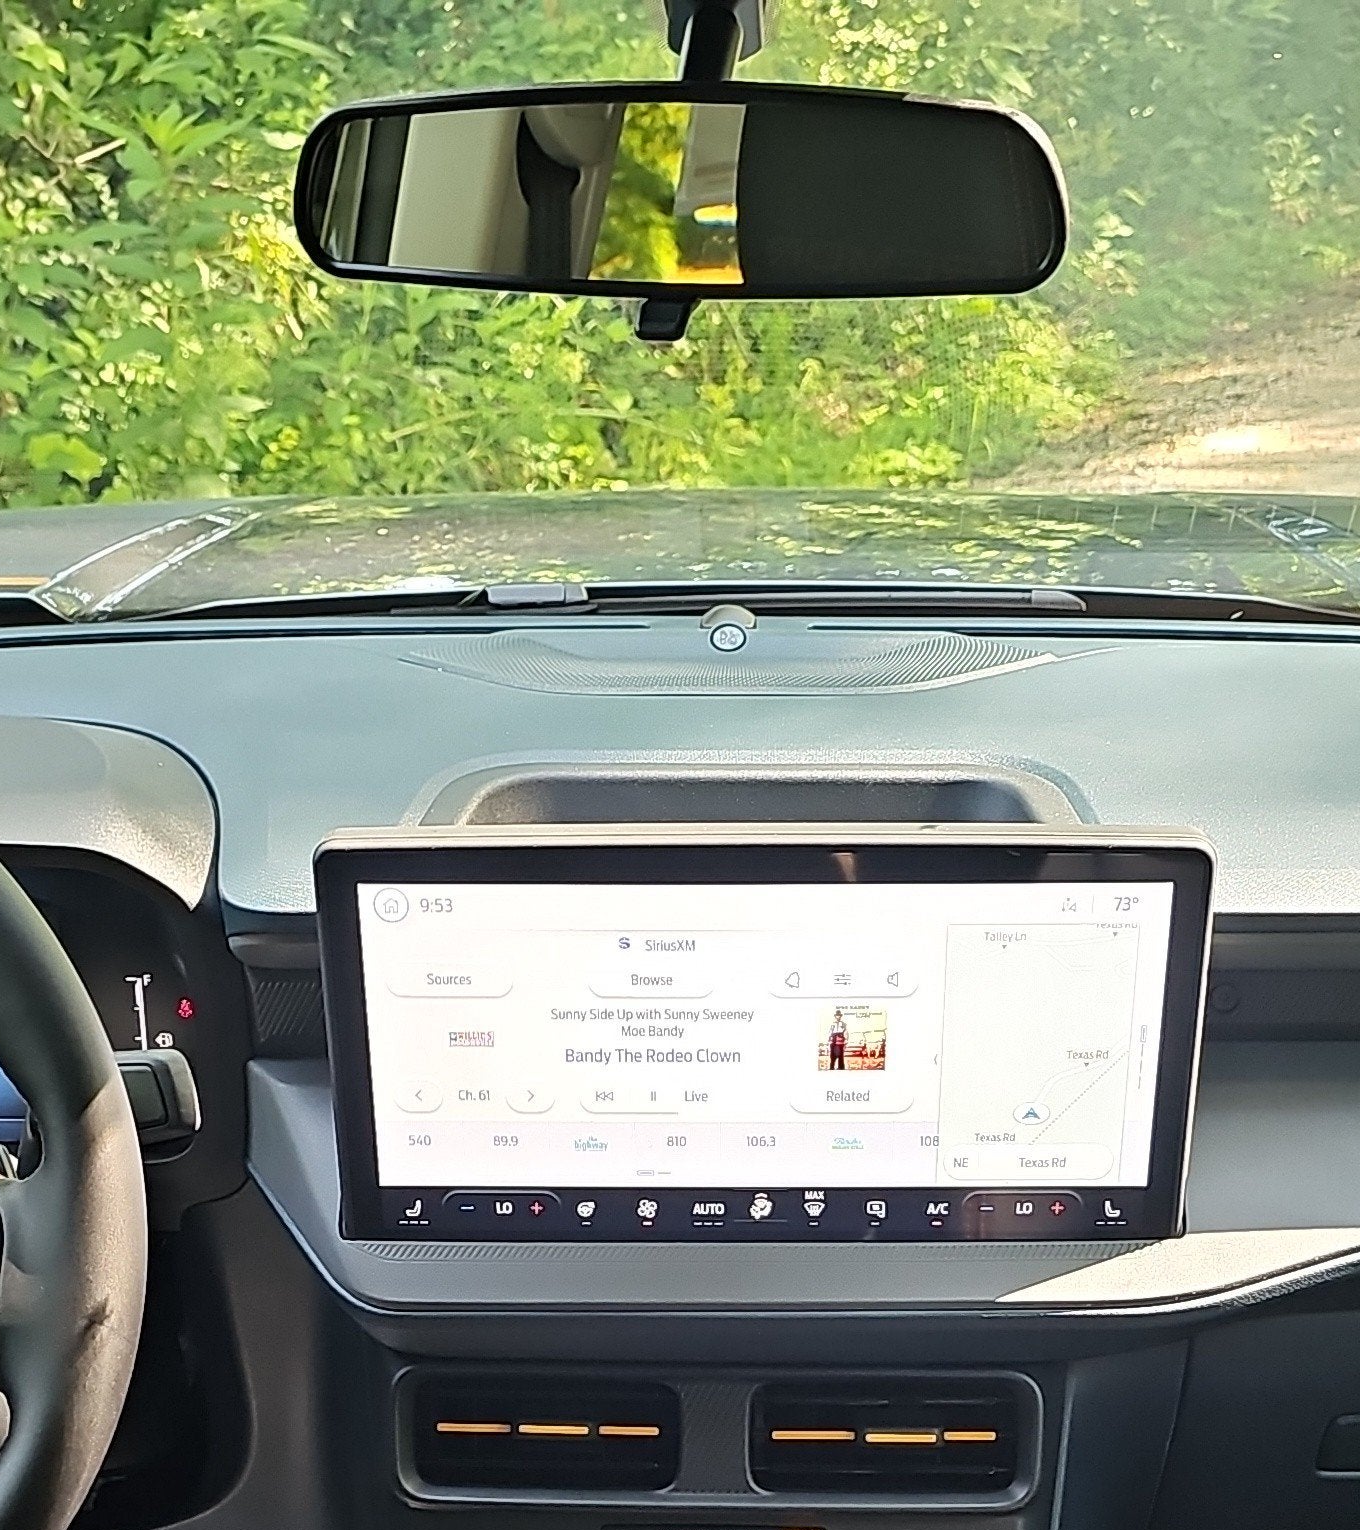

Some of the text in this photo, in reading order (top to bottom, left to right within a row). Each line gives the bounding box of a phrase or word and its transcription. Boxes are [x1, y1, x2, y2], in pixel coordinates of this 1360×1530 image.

[420, 899, 453, 913] 9:53
[985, 932, 1013, 943] Talley
[645, 940, 696, 951] SiriusXM
[143, 974, 151, 986] F
[427, 973, 472, 985] Sources
[631, 974, 673, 986] Browse
[551, 1009, 754, 1022] Sunny Side Up with Sunny Sweeney
[621, 1026, 684, 1038] Moe Bandy
[565, 1049, 741, 1065] Bandy The Rodeo Clown
[1067, 1050, 1109, 1060] Texas Rd
[459, 1090, 490, 1101] Ch. 61
[685, 1091, 708, 1102] Live
[827, 1091, 870, 1102] Related
[408, 1135, 431, 1146] 540
[493, 1136, 519, 1147] 89.9
[667, 1136, 687, 1147] 810
[747, 1136, 776, 1147] 106.3
[975, 1133, 1016, 1142] Texas Rd
[954, 1158, 969, 1168] NE
[1019, 1157, 1067, 1168] Texas Rd
[805, 1191, 824, 1200] MAX
[496, 1202, 513, 1215] LO
[693, 1203, 725, 1216] AUTO
[927, 1202, 949, 1216] A/C
[1016, 1202, 1033, 1215] LO
